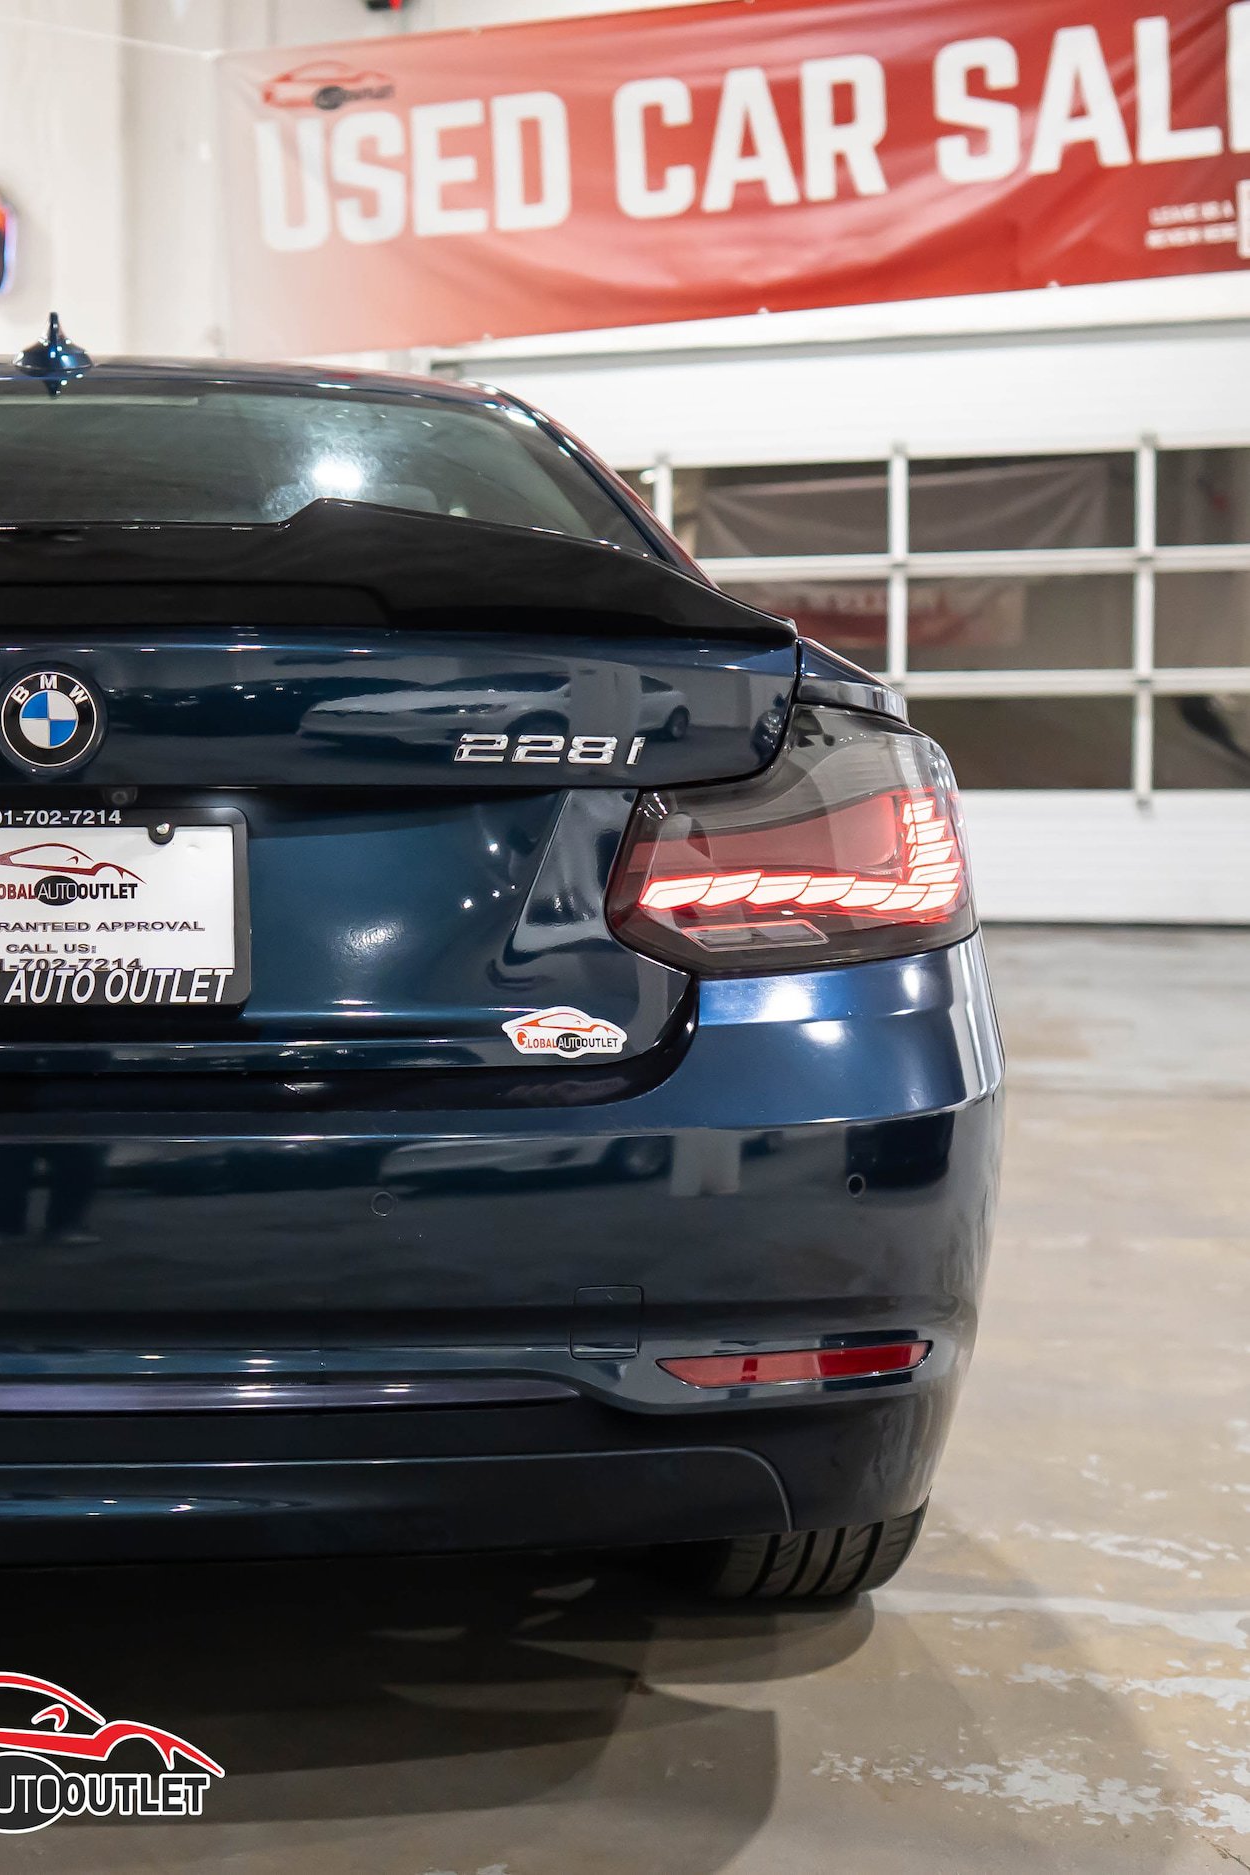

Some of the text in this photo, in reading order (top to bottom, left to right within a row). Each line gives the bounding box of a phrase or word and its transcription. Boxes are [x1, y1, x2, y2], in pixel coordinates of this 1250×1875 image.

[254, 91, 571, 252] USED
[613, 54, 888, 219] CAR
[11, 674, 89, 706] BMW
[453, 733, 646, 765] 228i
[96, 921, 205, 932] APPROVAL
[5, 943, 97, 954] CALL US:
[3, 969, 97, 1004] AUTO
[103, 969, 233, 1004] OUTLET
